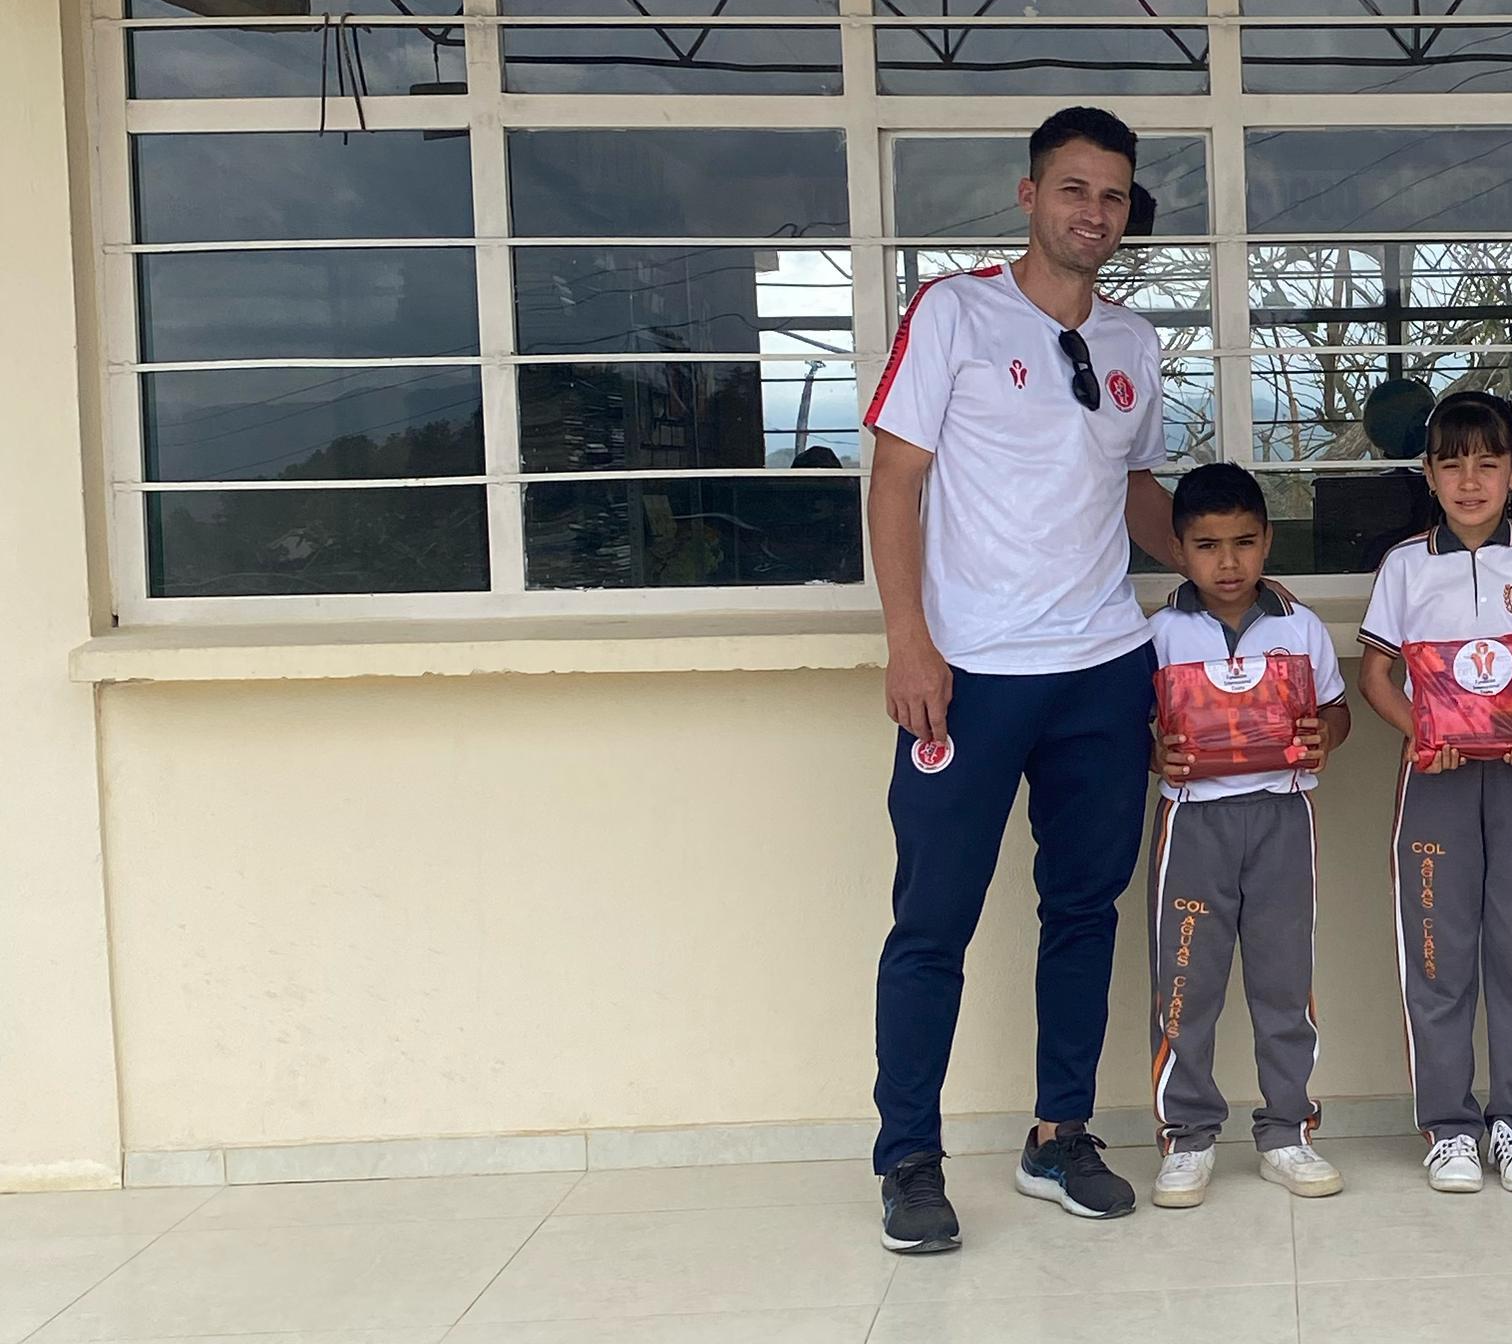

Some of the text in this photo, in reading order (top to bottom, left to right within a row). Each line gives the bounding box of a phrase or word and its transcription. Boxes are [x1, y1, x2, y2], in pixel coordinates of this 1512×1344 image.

[1411, 841, 1447, 855] COL
[1174, 897, 1210, 914] COL
[1420, 857, 1437, 980] AGUAS CLARAS
[1166, 915, 1196, 1039] AGUAS CLARAS
